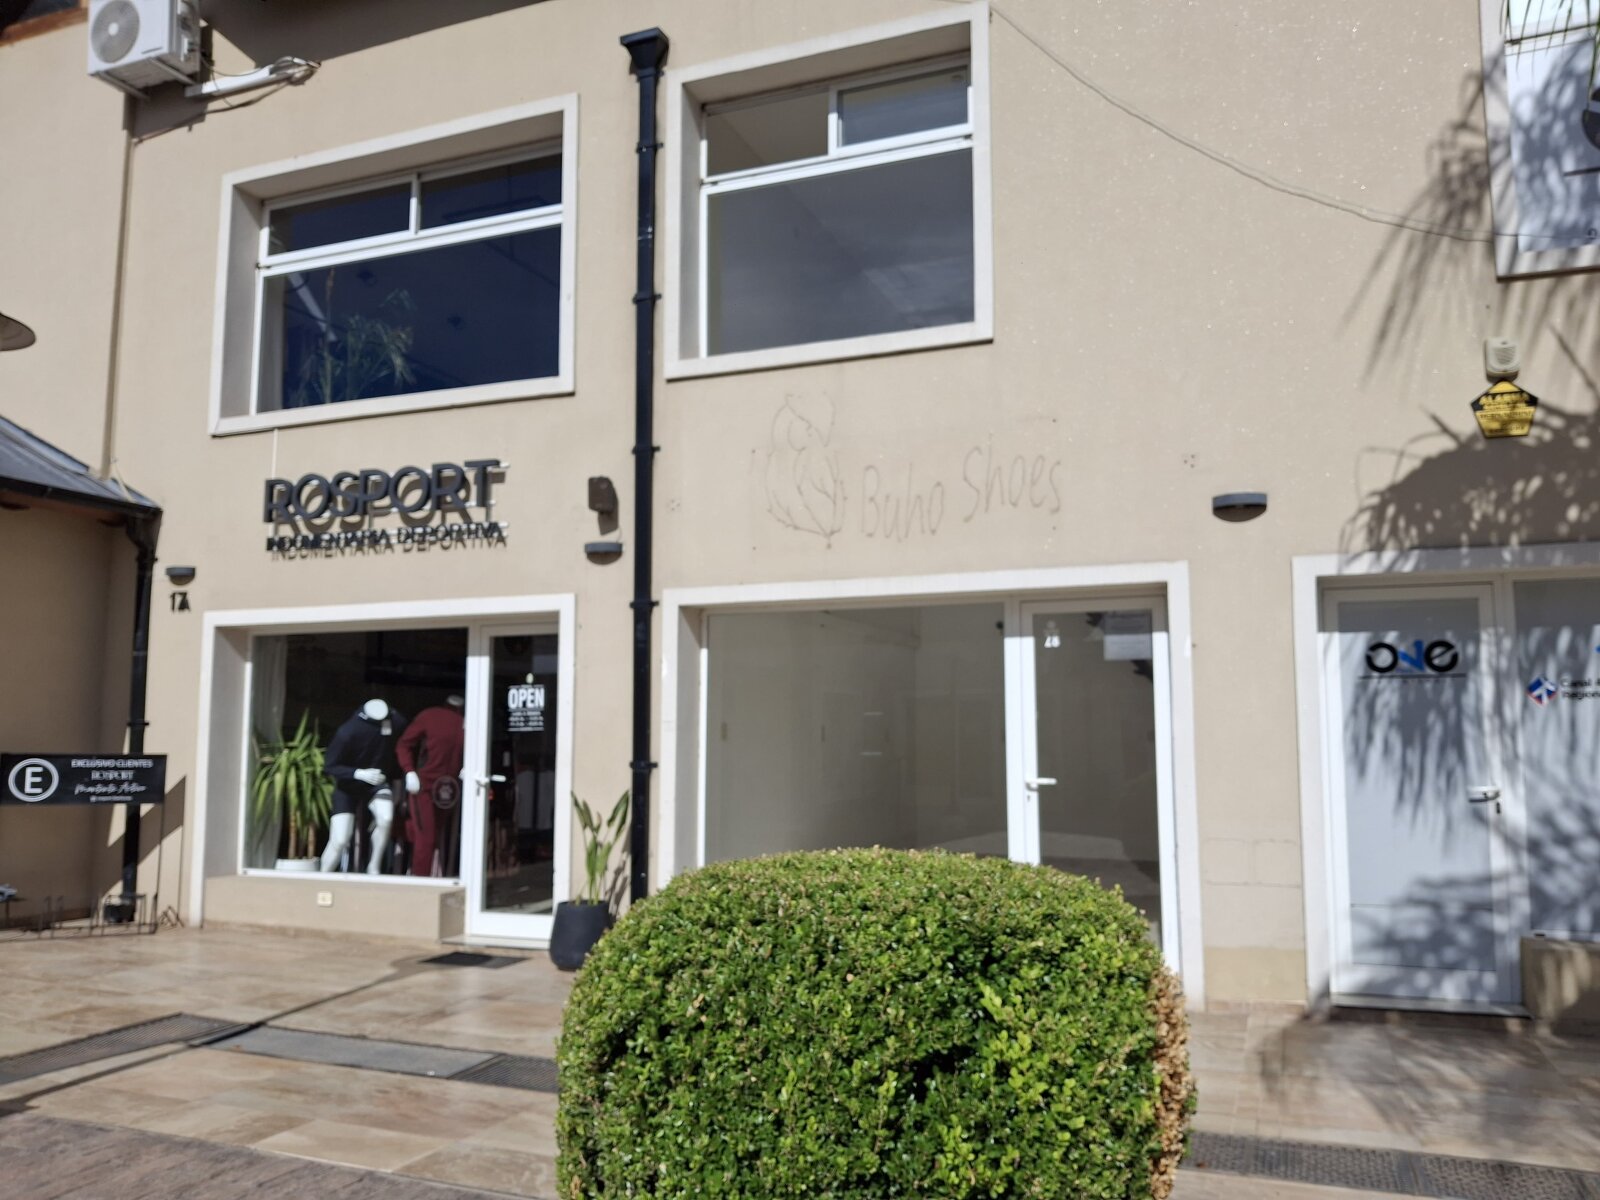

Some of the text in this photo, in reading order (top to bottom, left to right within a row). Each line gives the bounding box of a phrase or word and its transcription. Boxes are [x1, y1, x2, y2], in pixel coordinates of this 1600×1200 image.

[263, 459, 501, 523] ROSPORT
[861, 432, 1061, 543] Buho Shoes
[397, 521, 505, 545] DEPORTIVA
[508, 687, 545, 709] OPEN
[116, 759, 153, 768] CLIENTES
[24, 766, 44, 794] E
